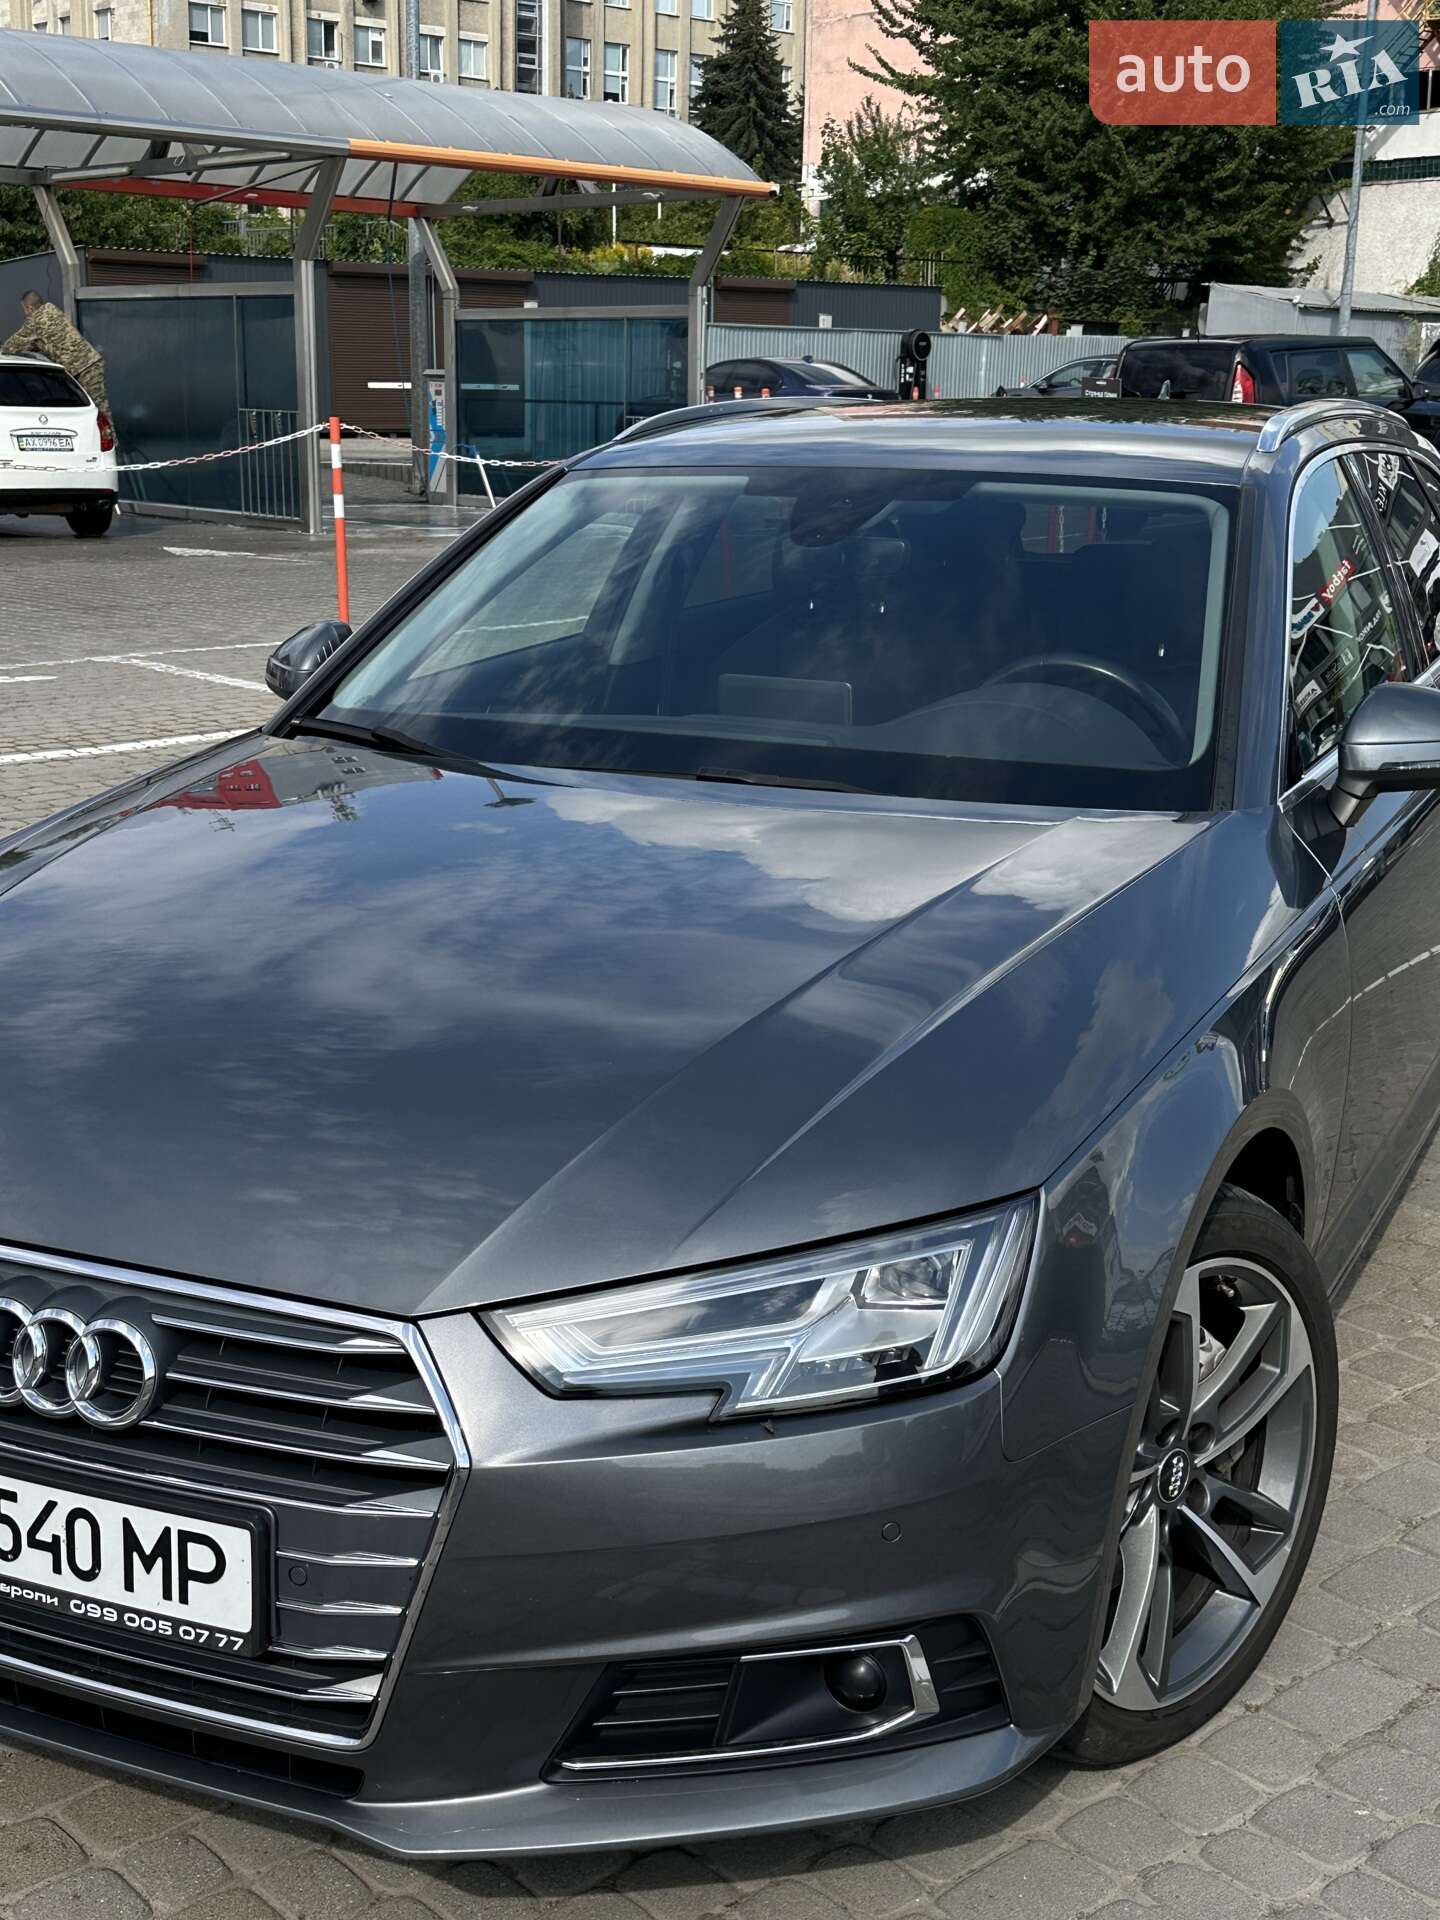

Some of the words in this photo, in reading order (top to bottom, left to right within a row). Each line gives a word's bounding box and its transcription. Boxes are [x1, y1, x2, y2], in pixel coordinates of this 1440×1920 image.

[123, 1517, 227, 1605] MP
[69, 1599, 118, 1622] 099
[123, 1613, 173, 1635] 005
[179, 1626, 210, 1643] 07
[214, 1633, 244, 1651] 77
